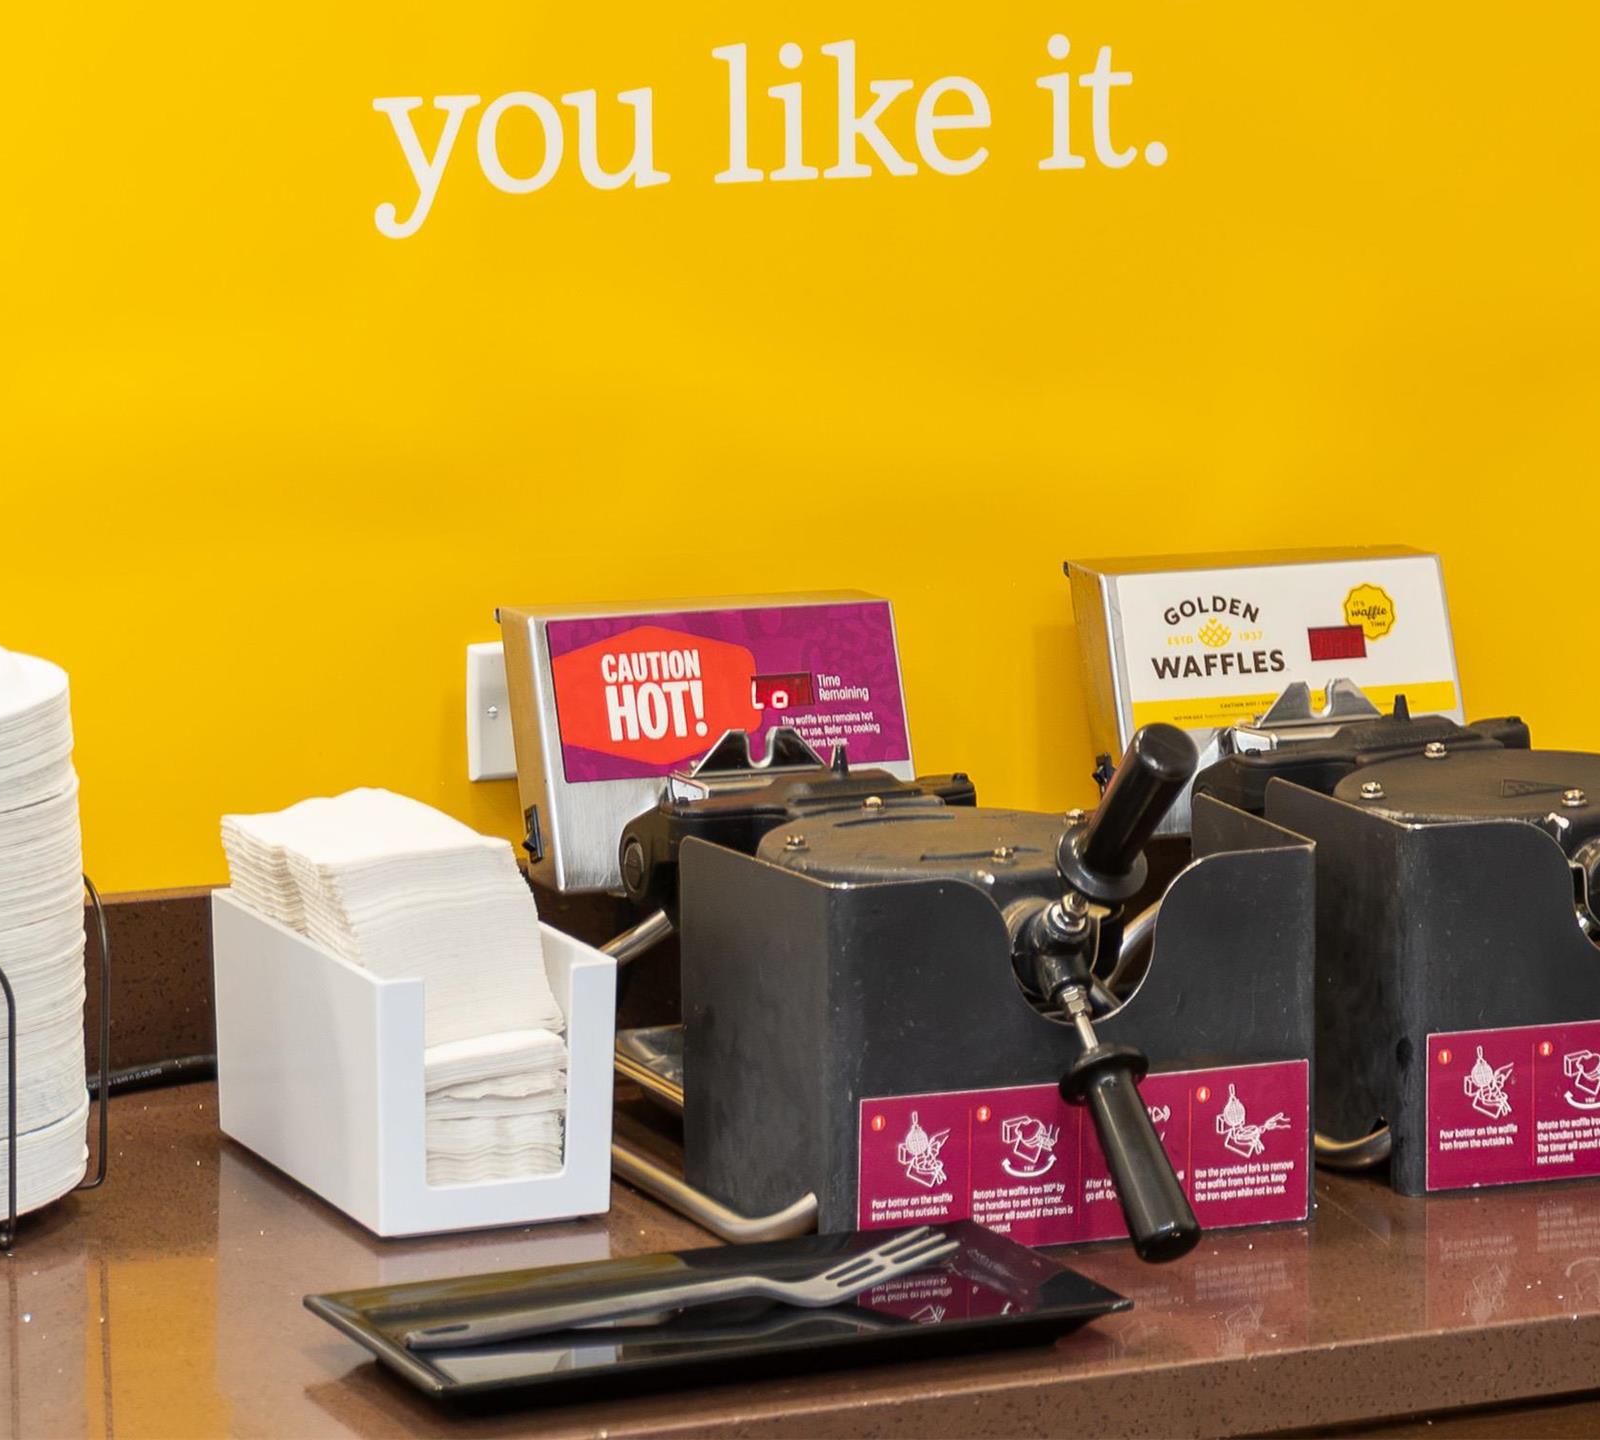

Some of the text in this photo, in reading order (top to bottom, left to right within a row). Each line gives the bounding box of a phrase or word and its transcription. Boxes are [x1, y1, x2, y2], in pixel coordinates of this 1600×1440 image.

[373, 33, 1168, 239] you like it.
[1164, 595, 1259, 625] GOLDEN
[1352, 605, 1386, 620] waffle
[601, 649, 701, 683] CAUTION
[1151, 649, 1286, 680] WAFFLES
[817, 674, 841, 687] Time
[819, 687, 870, 702] Remaining
[605, 680, 708, 742] HOT!
[781, 711, 873, 726] The waffle iron remains hot
[802, 725, 808, 735] in
[810, 726, 824, 736] use.
[824, 724, 843, 735] Refer
[844, 724, 852, 734] to
[853, 722, 881, 735] cooking
[827, 737, 849, 747] below.
[1543, 1042, 1550, 1056] 2
[1442, 1051, 1447, 1064] 1
[1200, 1087, 1207, 1101] 4
[980, 1108, 987, 1121] 2
[877, 1117, 882, 1130] 1
[1537, 1121, 1559, 1131] Rotate
[1559, 1119, 1571, 1129] the
[1571, 1117, 1590, 1128] waffle
[1440, 1123, 1518, 1140] Pour batter on the waffle
[1537, 1132, 1549, 1142] the
[1549, 1130, 1574, 1141] handles
[1574, 1129, 1582, 1139] to
[1583, 1128, 1593, 1138] set
[1440, 1140, 1453, 1151] iron
[1453, 1139, 1469, 1150] from
[1470, 1138, 1481, 1148] the
[1482, 1136, 1505, 1147] outside
[1537, 1143, 1549, 1153] The
[1549, 1142, 1567, 1152] timer
[1568, 1140, 1578, 1150] will
[1579, 1139, 1598, 1150] sound
[1537, 1155, 1548, 1165] not
[1195, 1168, 1207, 1179] Use
[1208, 1167, 1219, 1178] the
[1220, 1164, 1248, 1176] provided
[1249, 1163, 1261, 1173] fork
[1262, 1162, 1270, 1172] to
[1270, 1161, 1294, 1171] remove
[1086, 1179, 1102, 1189] After
[1195, 1180, 1206, 1191] the
[1207, 1178, 1227, 1189] waffle
[1228, 1177, 1244, 1187] from
[1244, 1176, 1256, 1186] the
[1271, 1173, 1287, 1184] Keep
[973, 1190, 995, 1200] Rotate
[996, 1188, 1007, 1197] the
[1009, 1186, 1028, 1197] waffle
[1029, 1185, 1042, 1194] iron
[1057, 1182, 1065, 1193] by
[1086, 1192, 1094, 1203] go
[1195, 1184, 1286, 1202] the iron open while not in use.
[872, 1193, 953, 1209] Pour batter on the waffle
[973, 1195, 1063, 1211] the handles to set the timer.
[872, 1211, 884, 1221] iron
[886, 1210, 902, 1219] from
[903, 1208, 914, 1218] the
[915, 1206, 939, 1217] outside
[973, 1205, 1073, 1223] The timer will sound if the iron is
